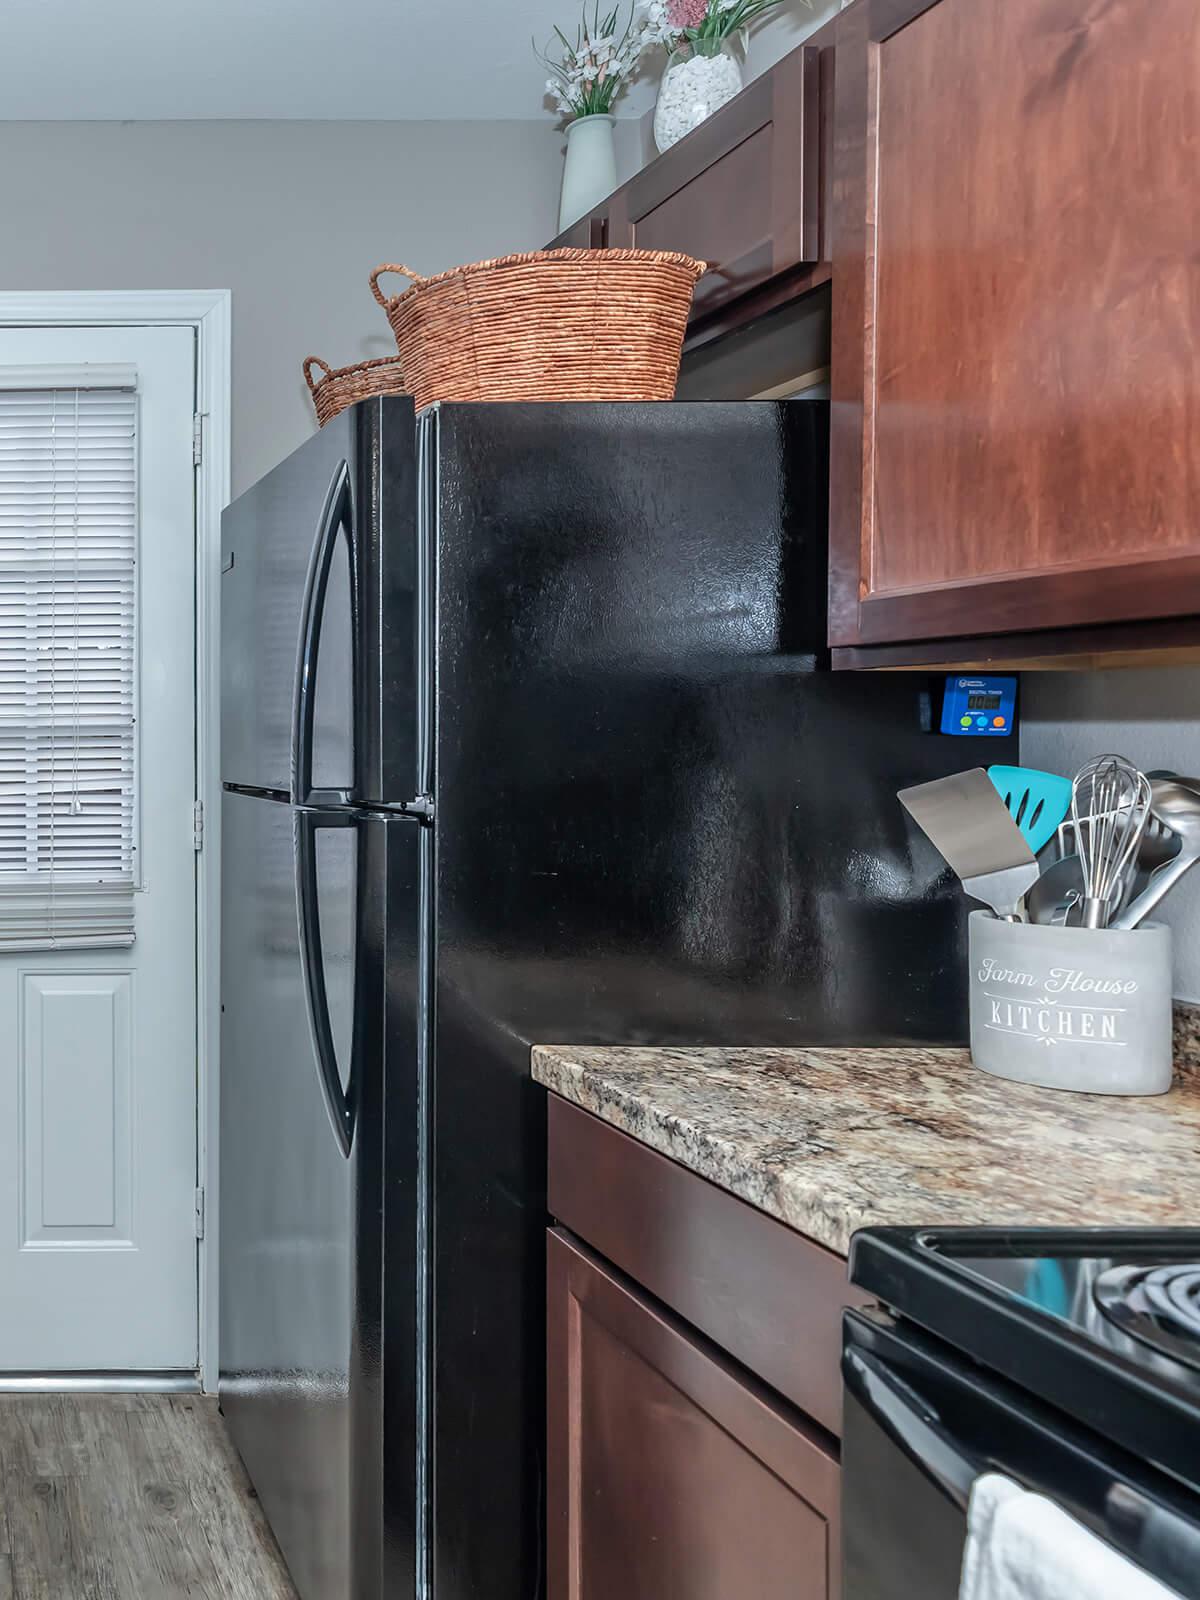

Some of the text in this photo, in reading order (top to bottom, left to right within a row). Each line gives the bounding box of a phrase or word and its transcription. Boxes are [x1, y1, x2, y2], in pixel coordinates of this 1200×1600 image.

[978, 958, 1138, 995] Farm House
[990, 1000, 1116, 1039] KITCHEN
